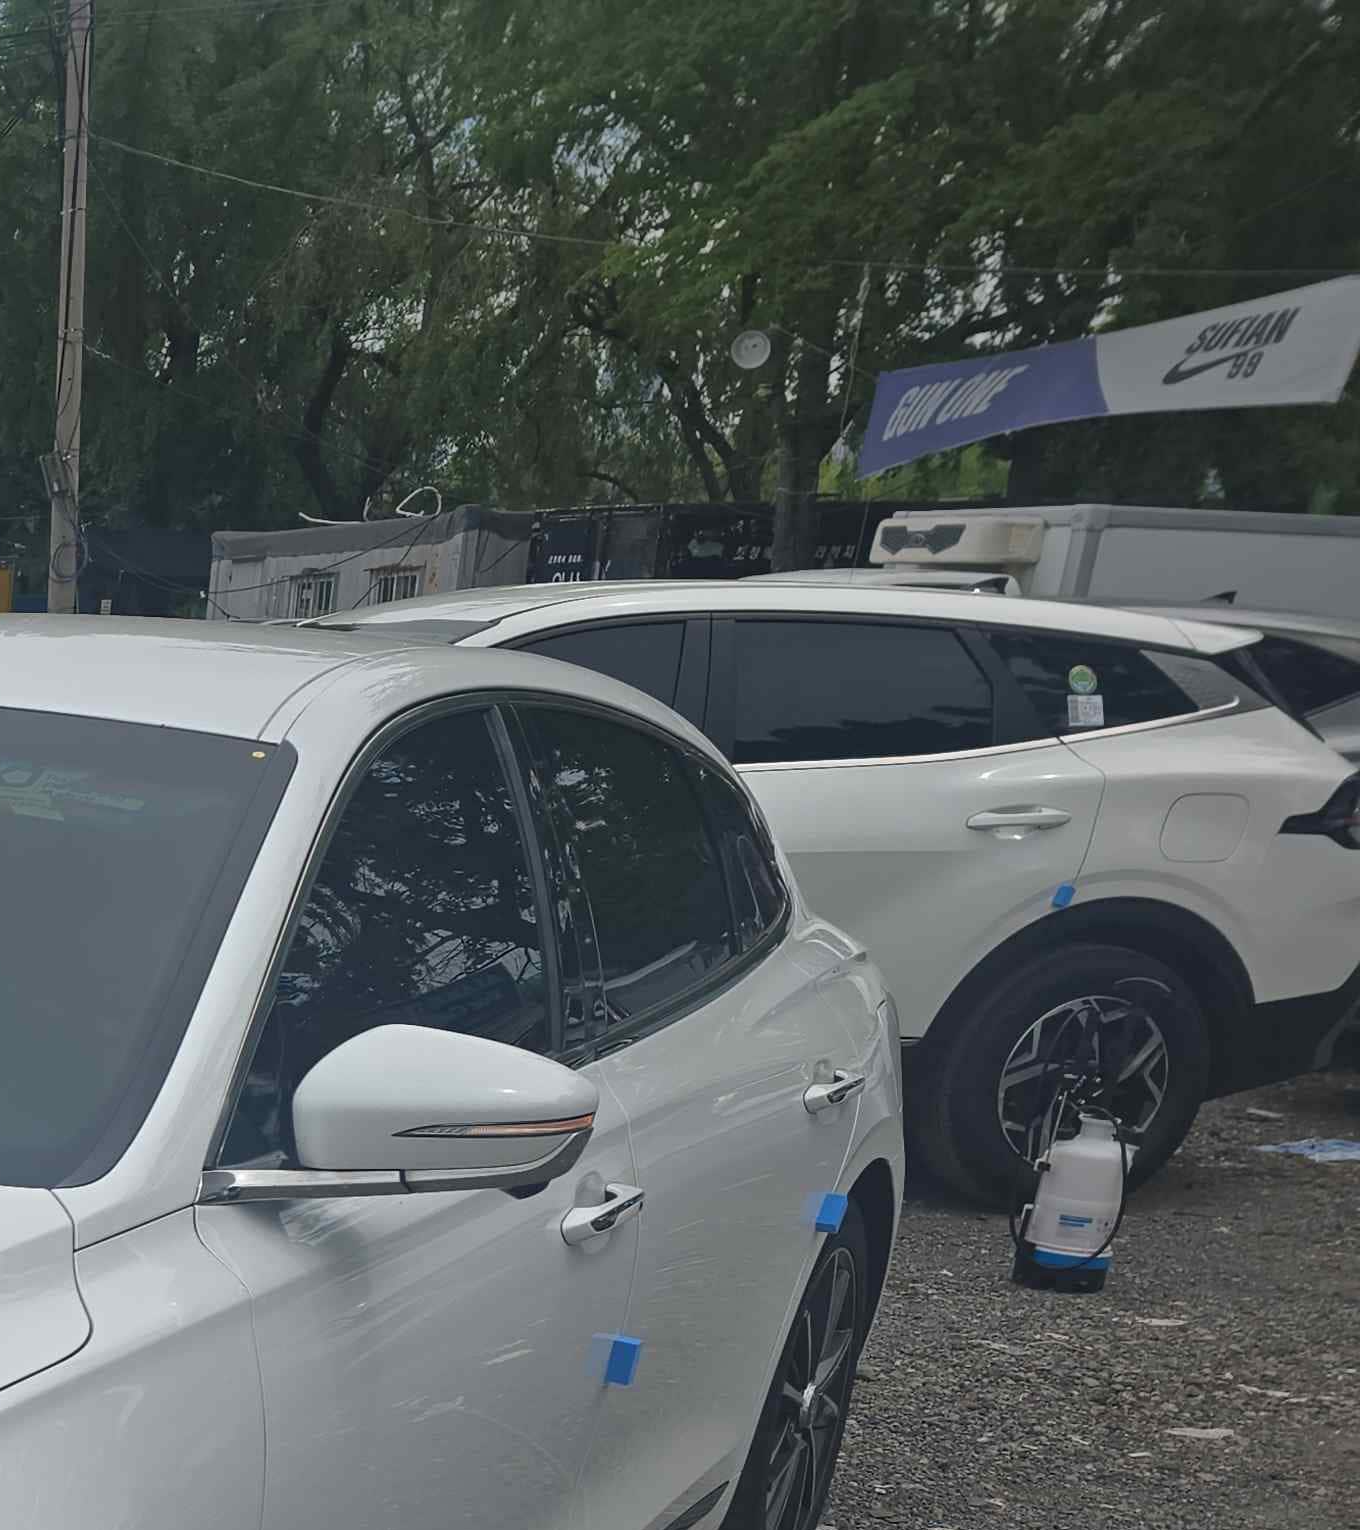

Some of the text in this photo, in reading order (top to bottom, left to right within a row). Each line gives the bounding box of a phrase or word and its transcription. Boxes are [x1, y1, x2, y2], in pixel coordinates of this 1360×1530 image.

[1185, 306, 1302, 355] SUFIAN
[1227, 350, 1265, 379] 99
[935, 363, 1030, 425] ONE
